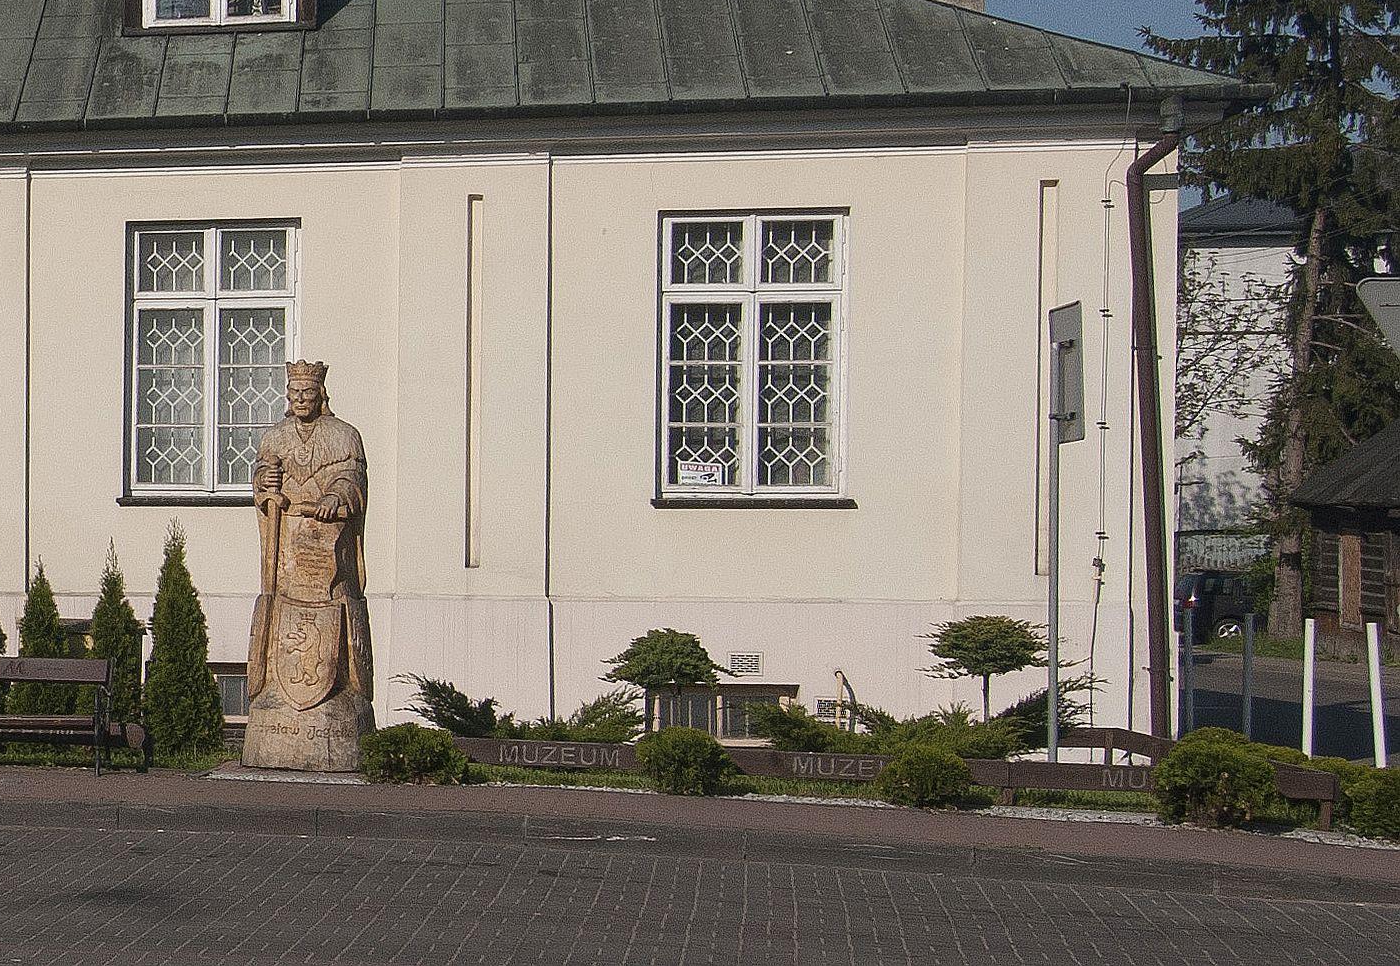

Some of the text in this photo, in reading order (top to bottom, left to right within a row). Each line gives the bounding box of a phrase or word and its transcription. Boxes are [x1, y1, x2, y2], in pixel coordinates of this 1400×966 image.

[681, 464, 719, 472] UWAGA
[499, 744, 620, 767] MUZEUM
[793, 756, 883, 777] MUZE
